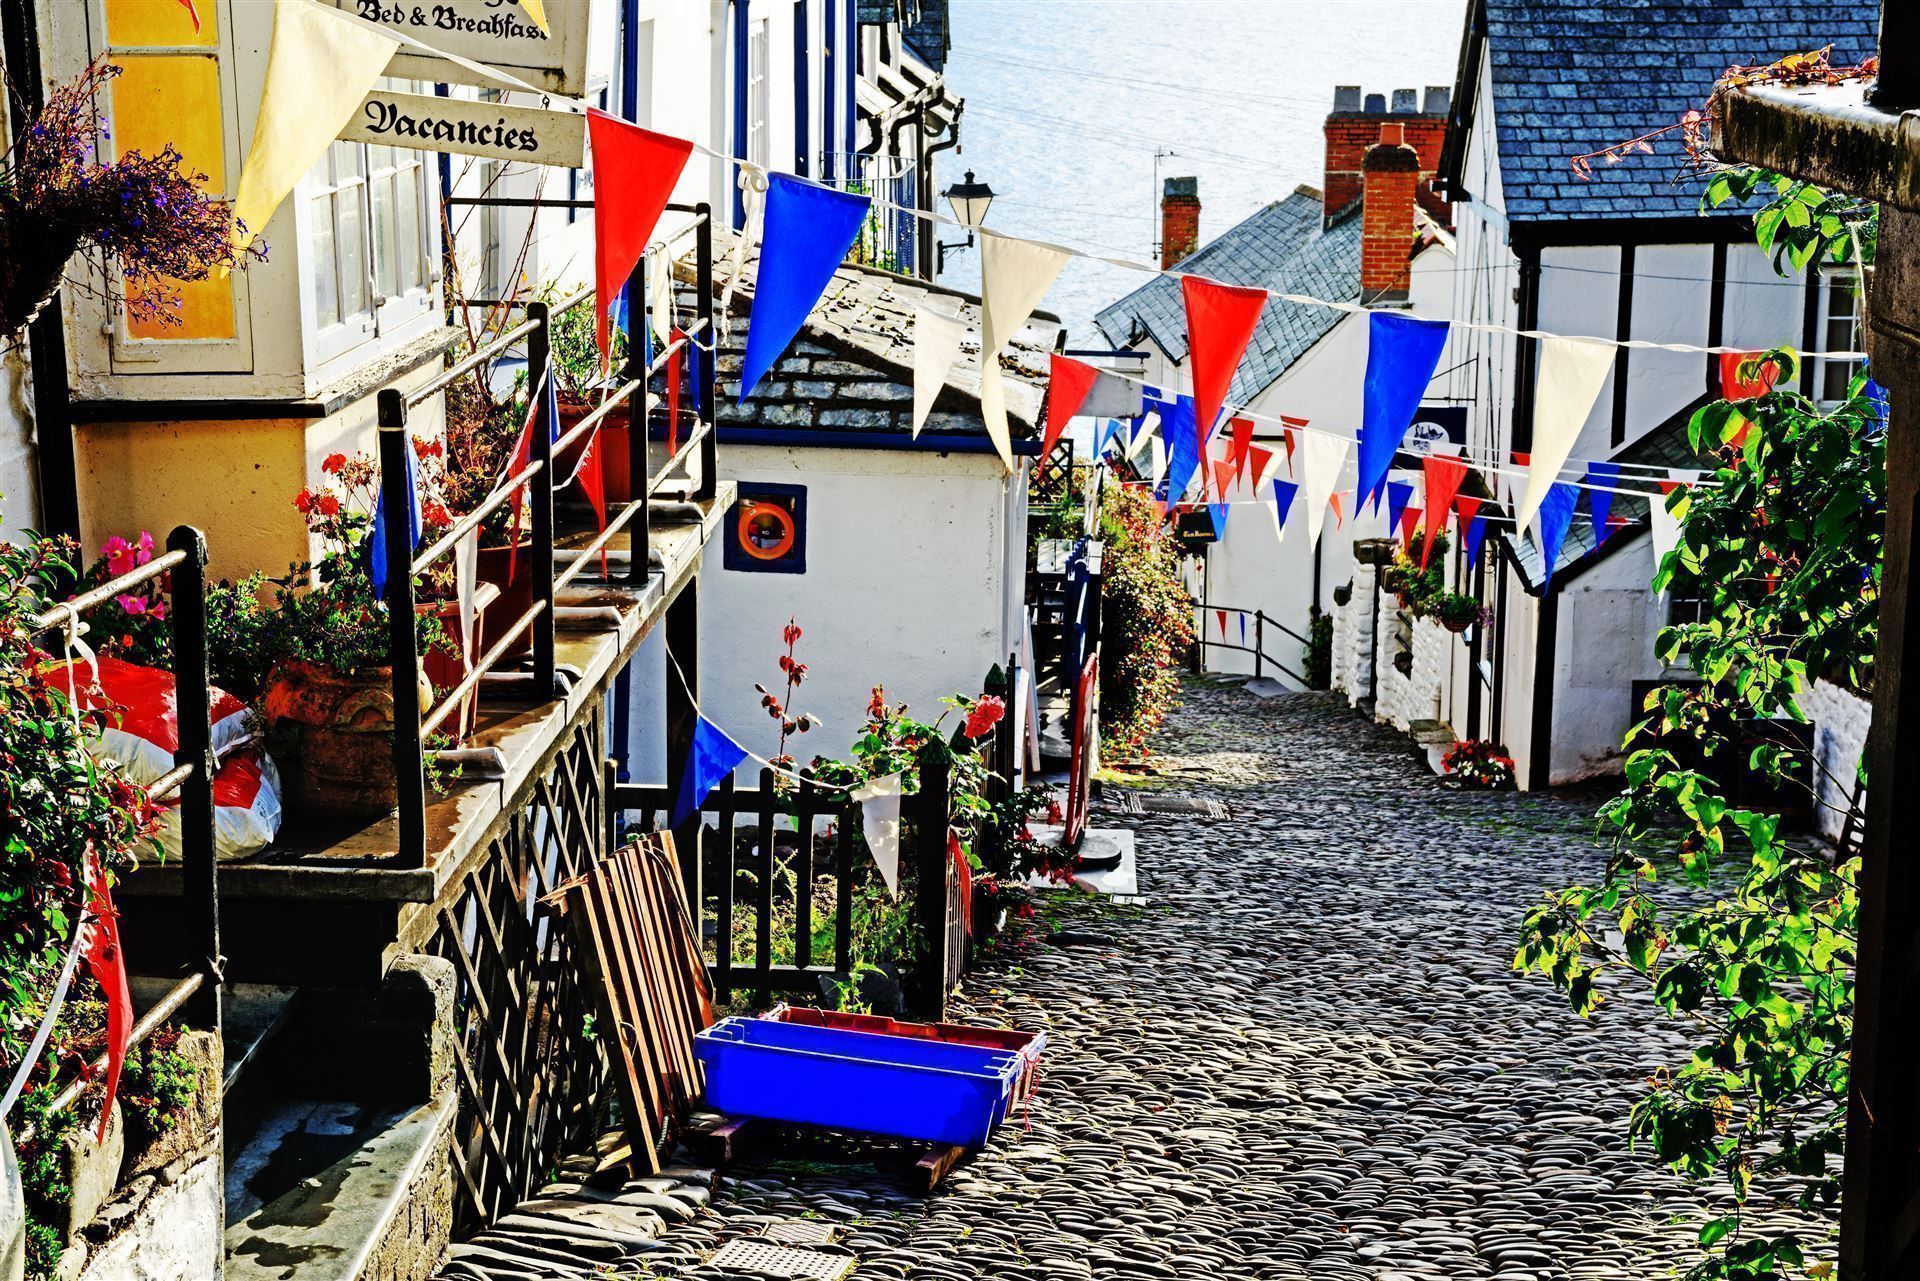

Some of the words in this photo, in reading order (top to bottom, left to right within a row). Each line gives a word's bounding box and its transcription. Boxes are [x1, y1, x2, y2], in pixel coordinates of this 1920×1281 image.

[357, 0, 405, 25] Bed
[409, 6, 429, 26] &
[364, 100, 539, 152] Vacancies
